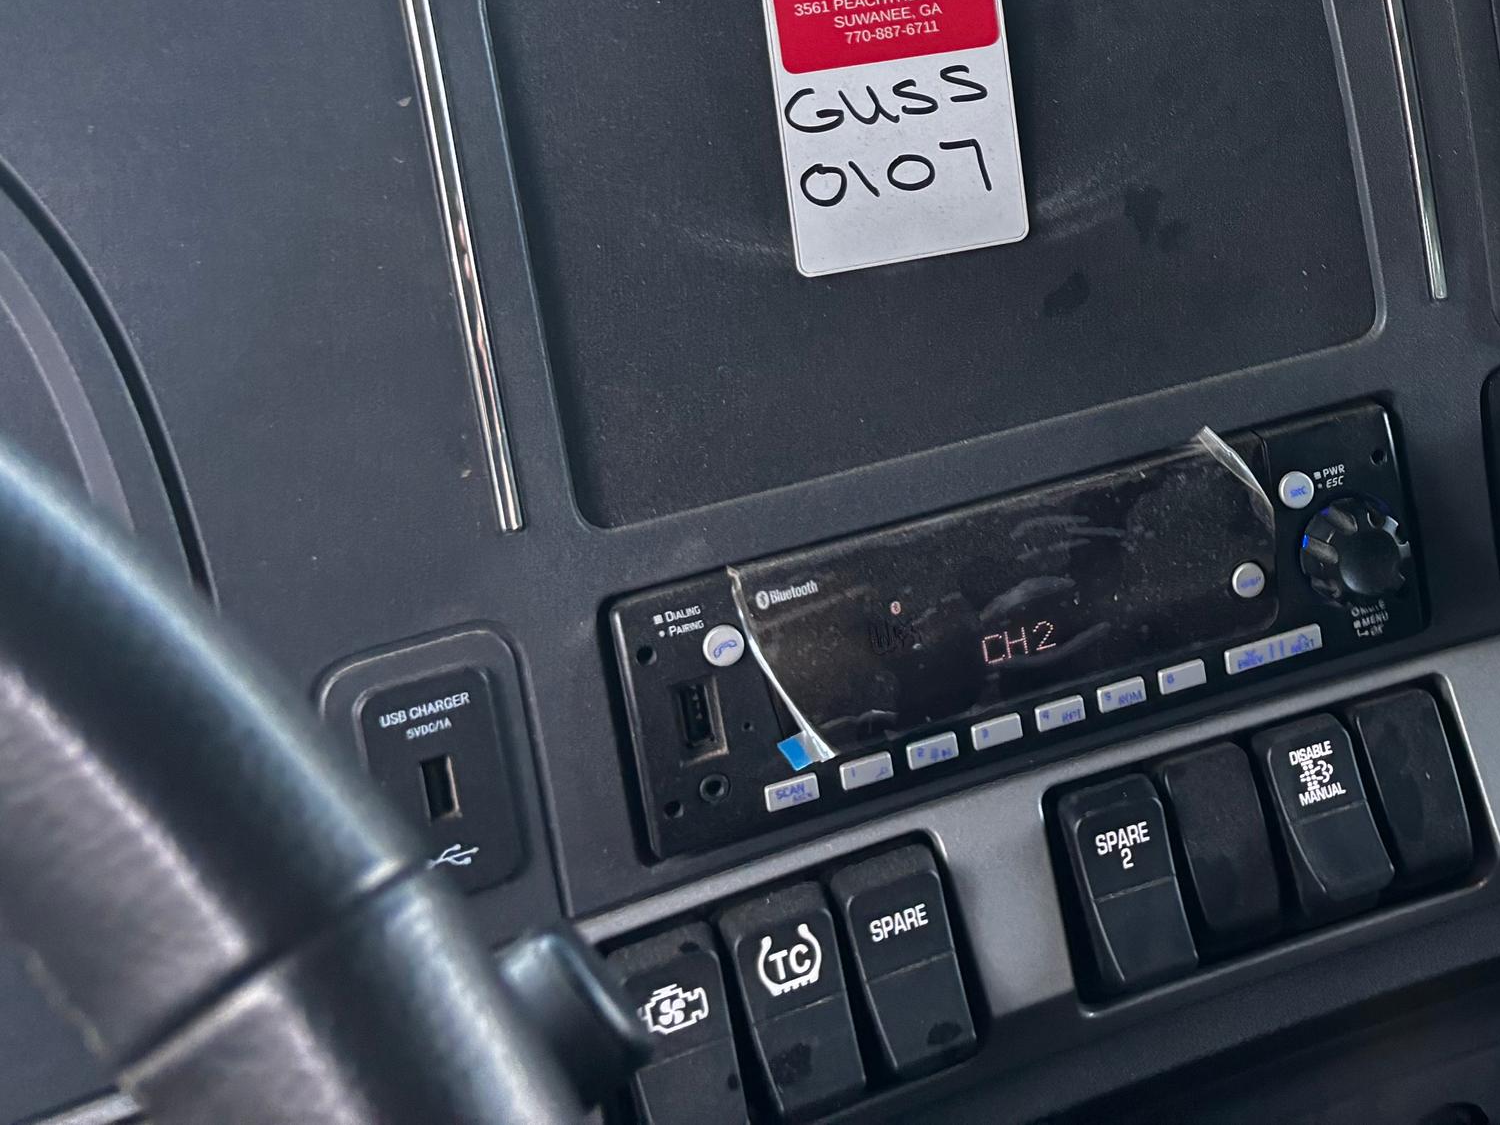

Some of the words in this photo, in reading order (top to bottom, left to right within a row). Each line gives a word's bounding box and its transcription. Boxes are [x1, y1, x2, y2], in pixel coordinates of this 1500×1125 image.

[794, 0, 830, 17] 3561
[833, 7, 916, 29] SUWANEE,
[919, 2, 943, 17] GA
[844, 20, 940, 44] 770-887-6711
[783, 64, 989, 134] GUSS
[800, 138, 992, 208] 0107
[1322, 463, 1346, 478] PWR
[1325, 475, 1344, 489] ESC
[769, 579, 819, 604] Bluetooth
[1361, 610, 1389, 627] MENU
[981, 620, 1057, 665] CH2
[379, 710, 407, 728] USB
[409, 692, 471, 720] CHARGER
[1288, 740, 1334, 767] DISABLE
[775, 783, 805, 801] SCAN
[1298, 781, 1347, 807] MANUAL
[1095, 820, 1150, 856] SPARE
[1121, 847, 1134, 870] 2
[869, 903, 929, 943] SPARE
[768, 943, 812, 981] TC
